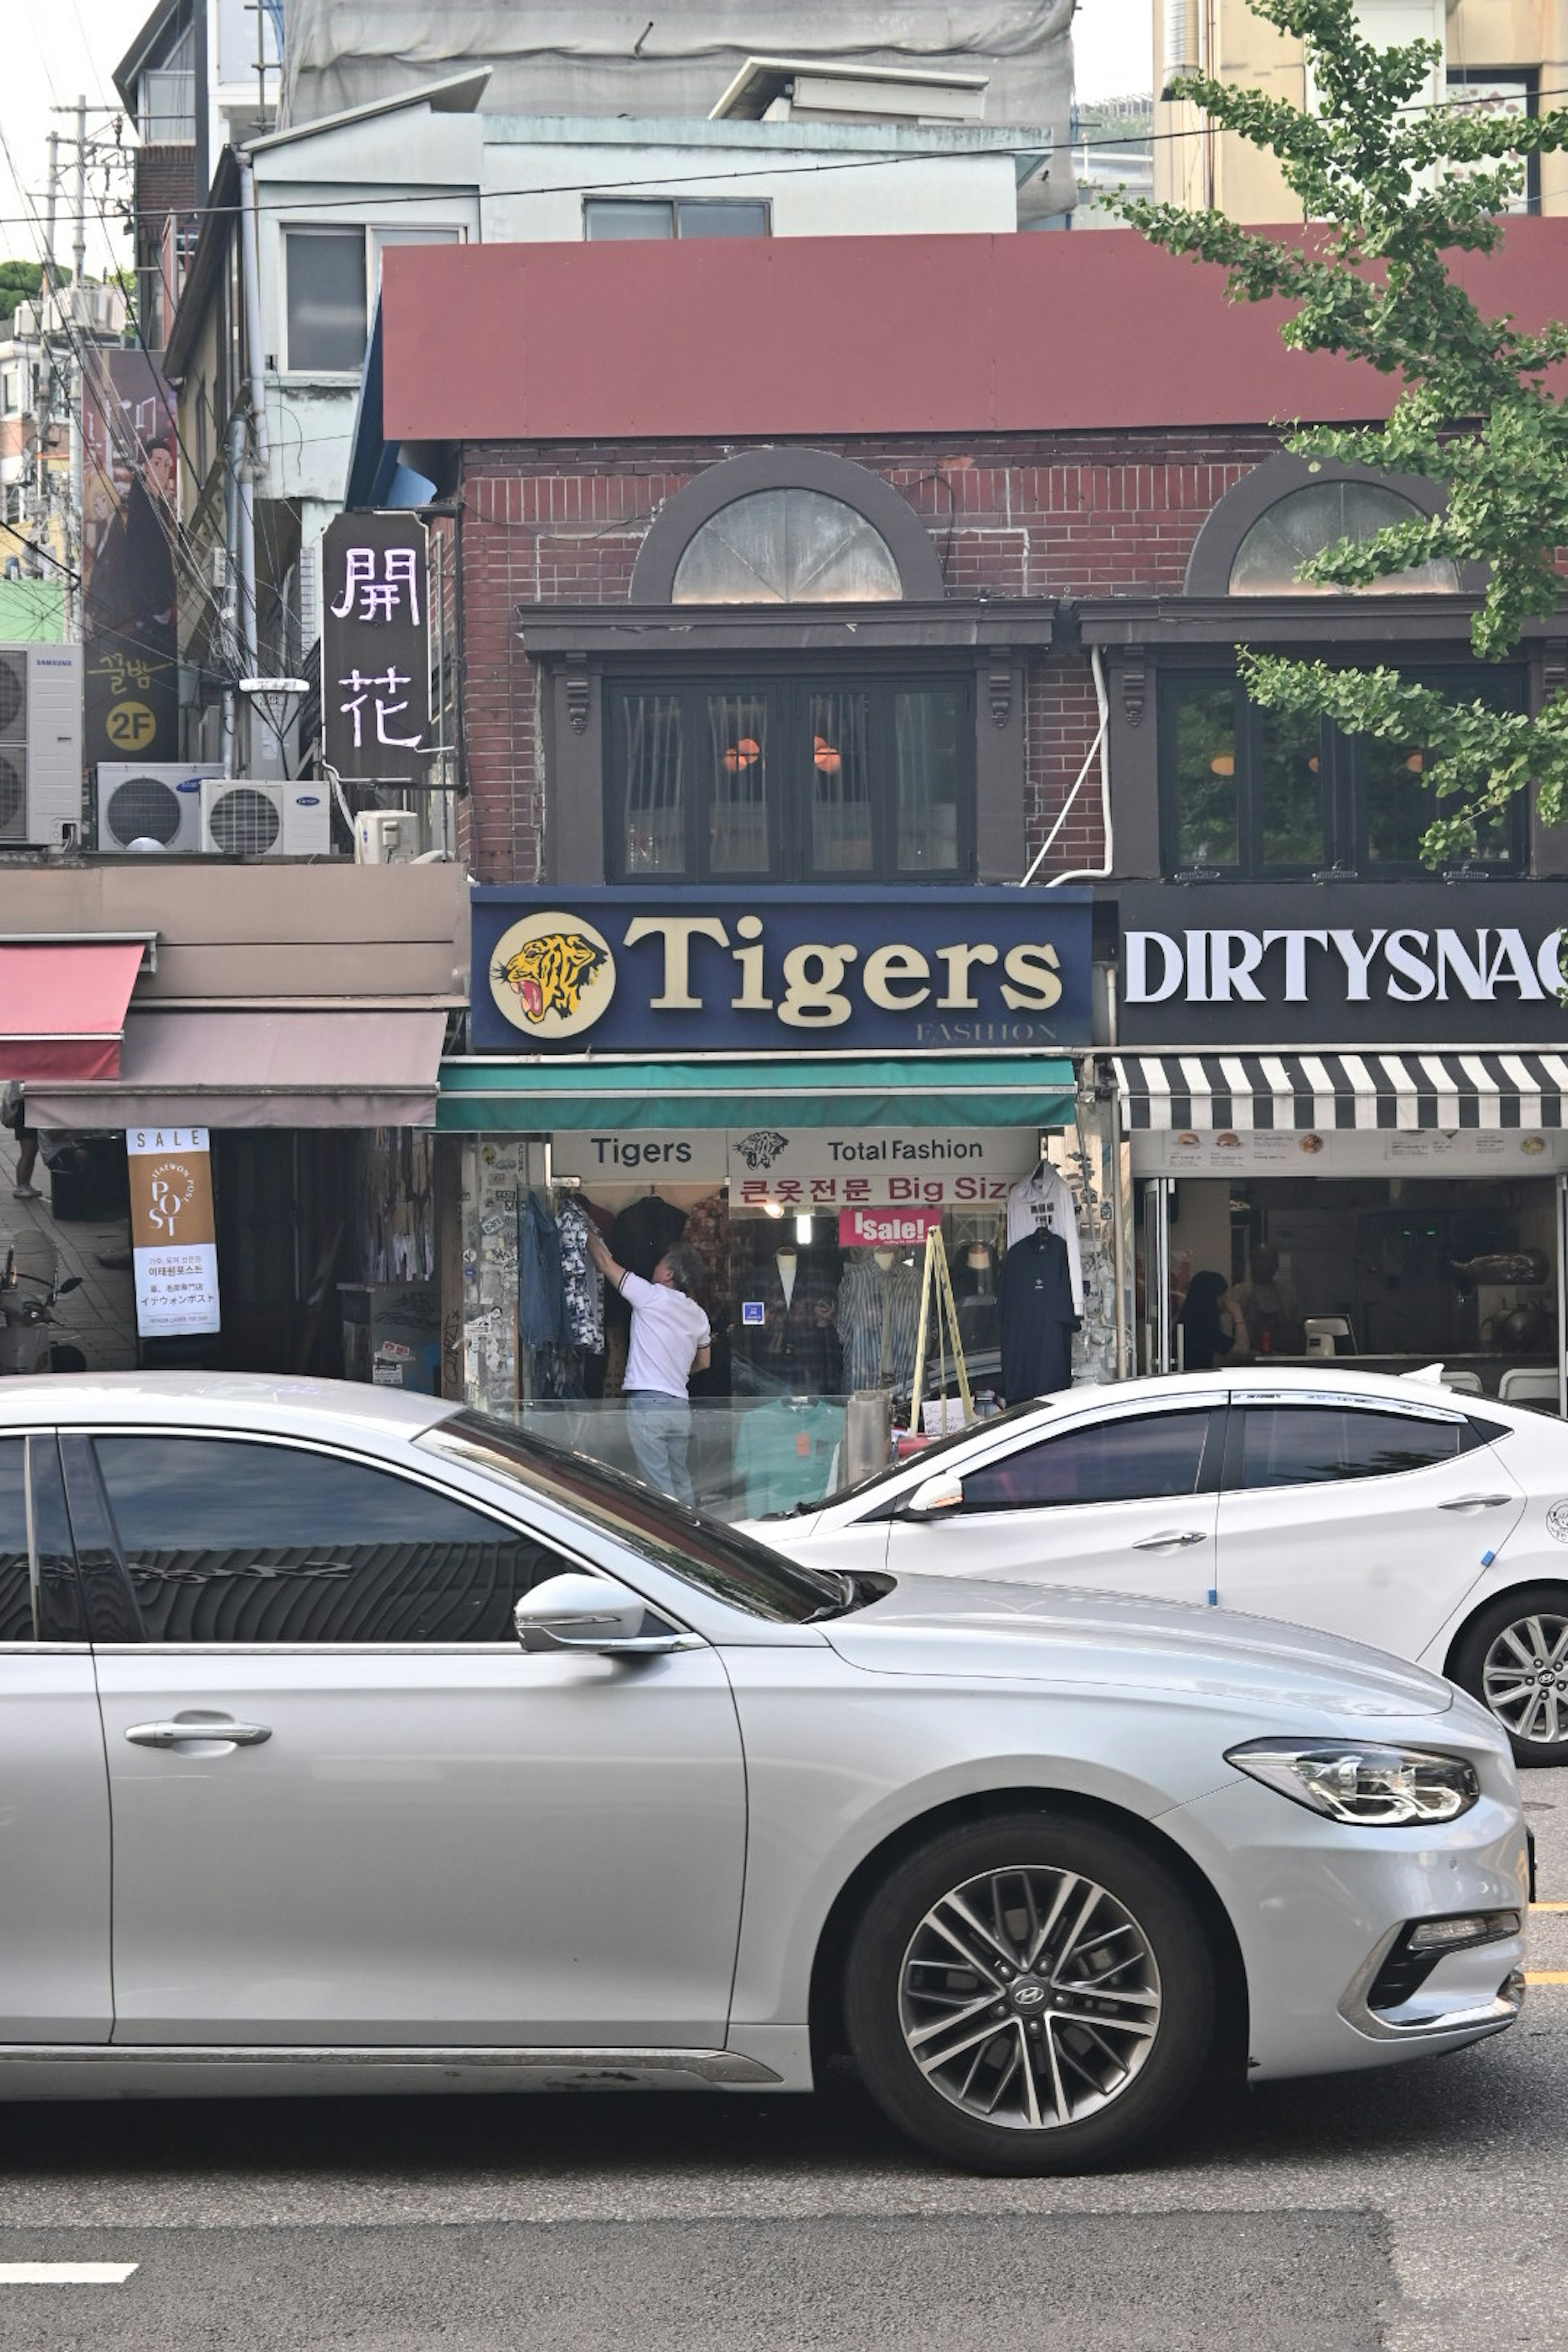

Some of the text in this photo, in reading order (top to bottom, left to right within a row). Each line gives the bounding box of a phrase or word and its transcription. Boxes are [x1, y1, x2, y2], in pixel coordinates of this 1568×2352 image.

[330, 548, 423, 748] 開花
[112, 712, 151, 740] 2F
[622, 915, 1063, 1028] Tigers
[917, 1023, 1057, 1041] FASHION
[137, 1130, 200, 1147] SALE
[892, 1139, 983, 1160] Fashion
[590, 1138, 692, 1167] Tigers
[740, 1177, 1018, 1203] 큰옷전문 Big Siz
